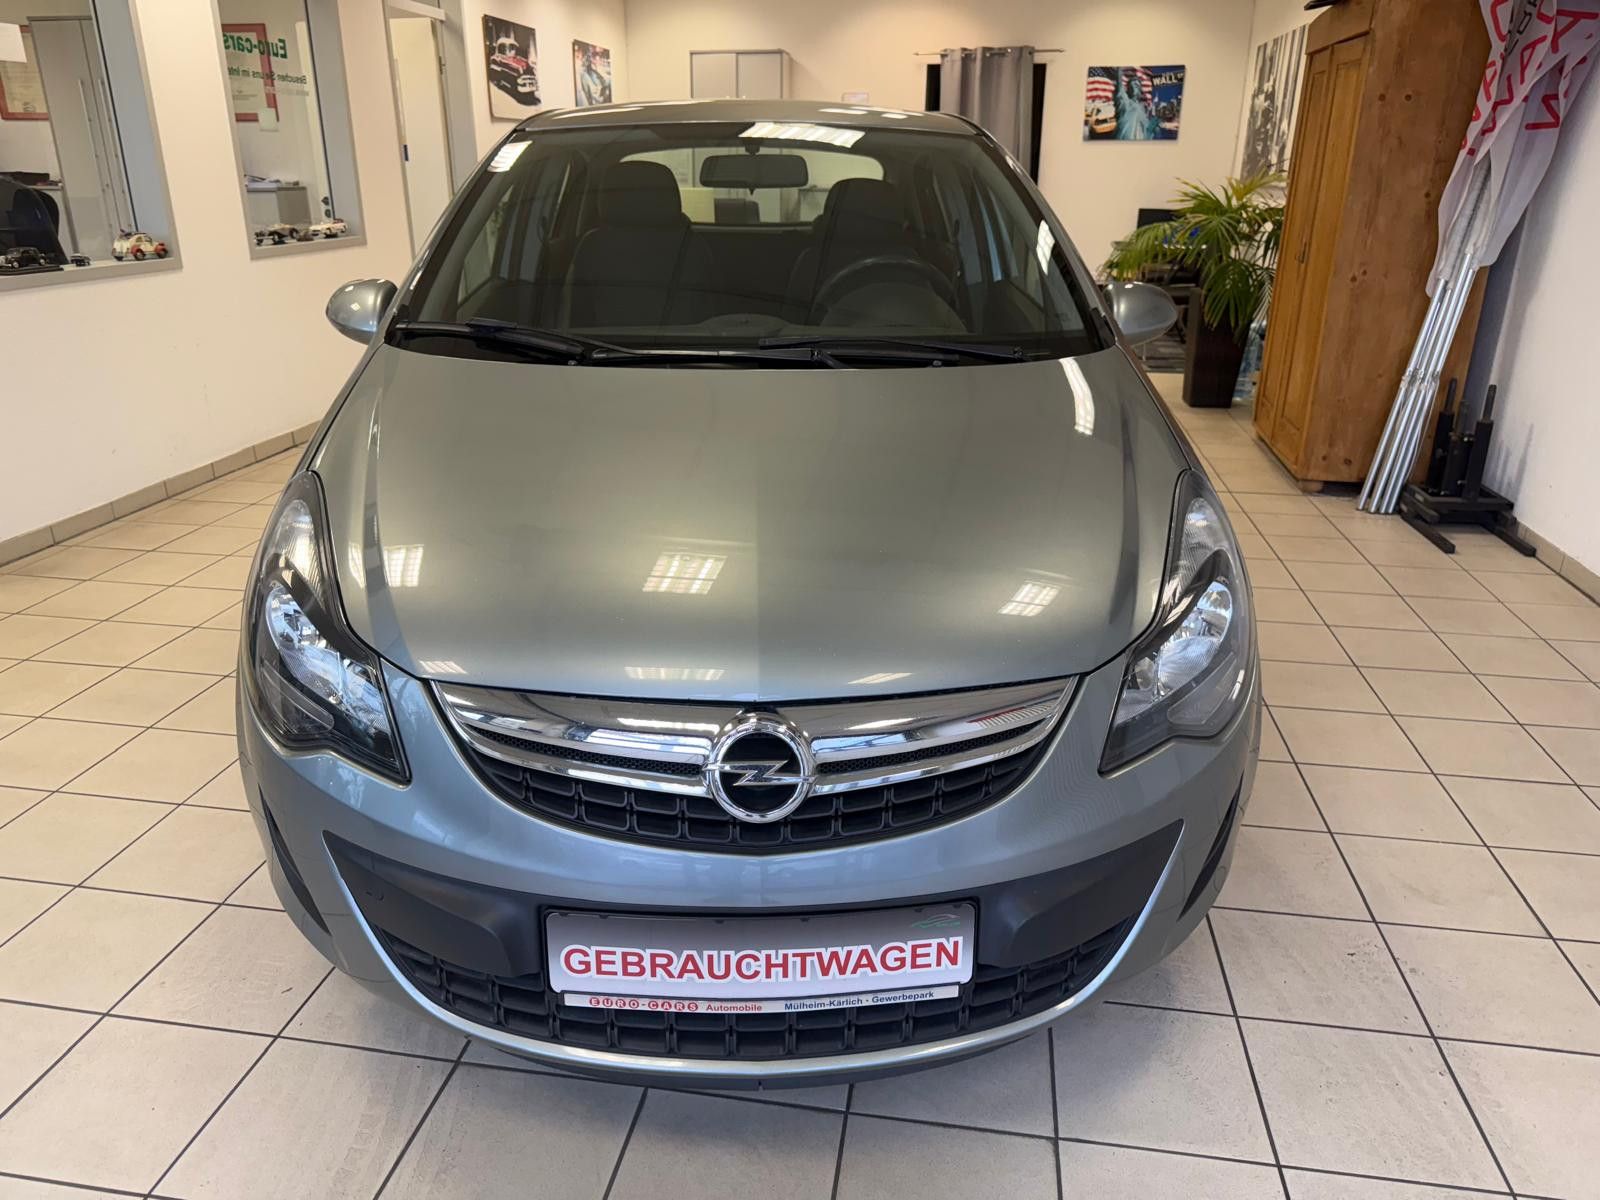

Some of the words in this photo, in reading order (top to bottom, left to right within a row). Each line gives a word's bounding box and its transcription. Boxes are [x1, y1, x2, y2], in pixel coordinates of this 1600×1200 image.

[563, 938, 960, 980] GEBRAUCHTWAGEN
[589, 997, 698, 1011] EURO-CARS
[706, 1003, 762, 1012] Automobile
[785, 998, 863, 1011] Mülheim-Kärlich
[872, 991, 934, 1004] Gewerbepark
